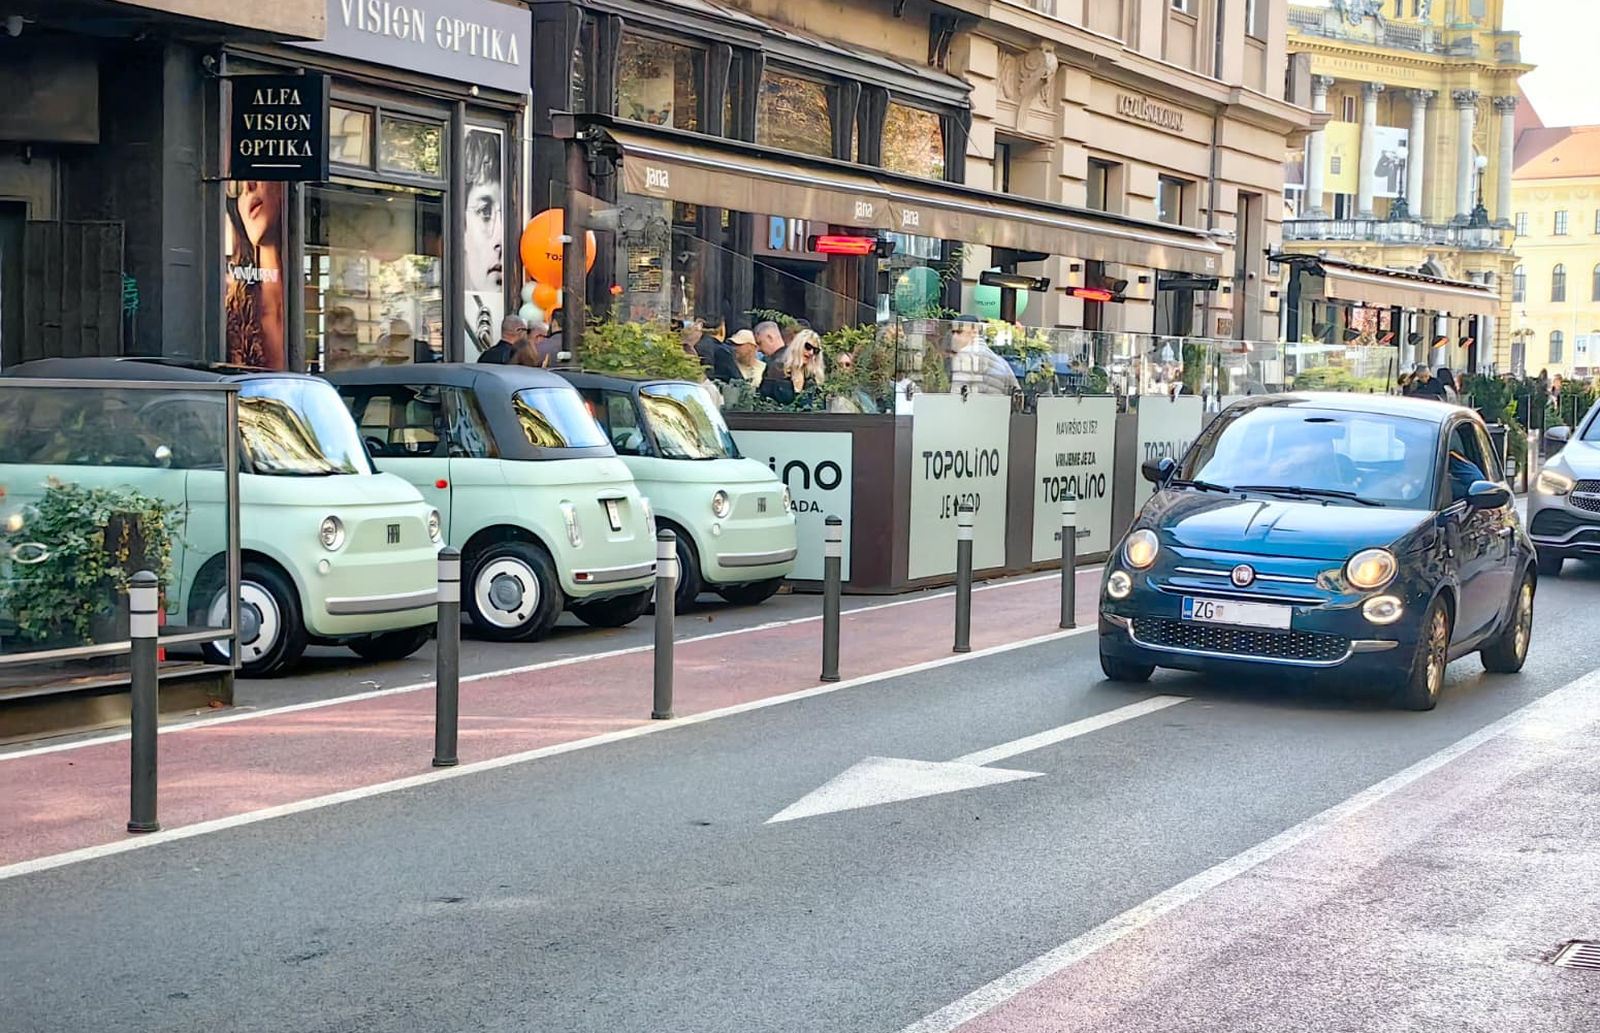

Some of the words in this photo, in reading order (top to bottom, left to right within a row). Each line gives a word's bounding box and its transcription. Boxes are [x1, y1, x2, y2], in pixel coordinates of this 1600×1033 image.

[340, 0, 426, 44] VISION
[435, 15, 520, 66] OPTIKA
[252, 88, 302, 105] ALFA
[243, 113, 311, 131] VISION
[239, 139, 313, 157] OPTIKA
[1194, 601, 1214, 619] ZG
